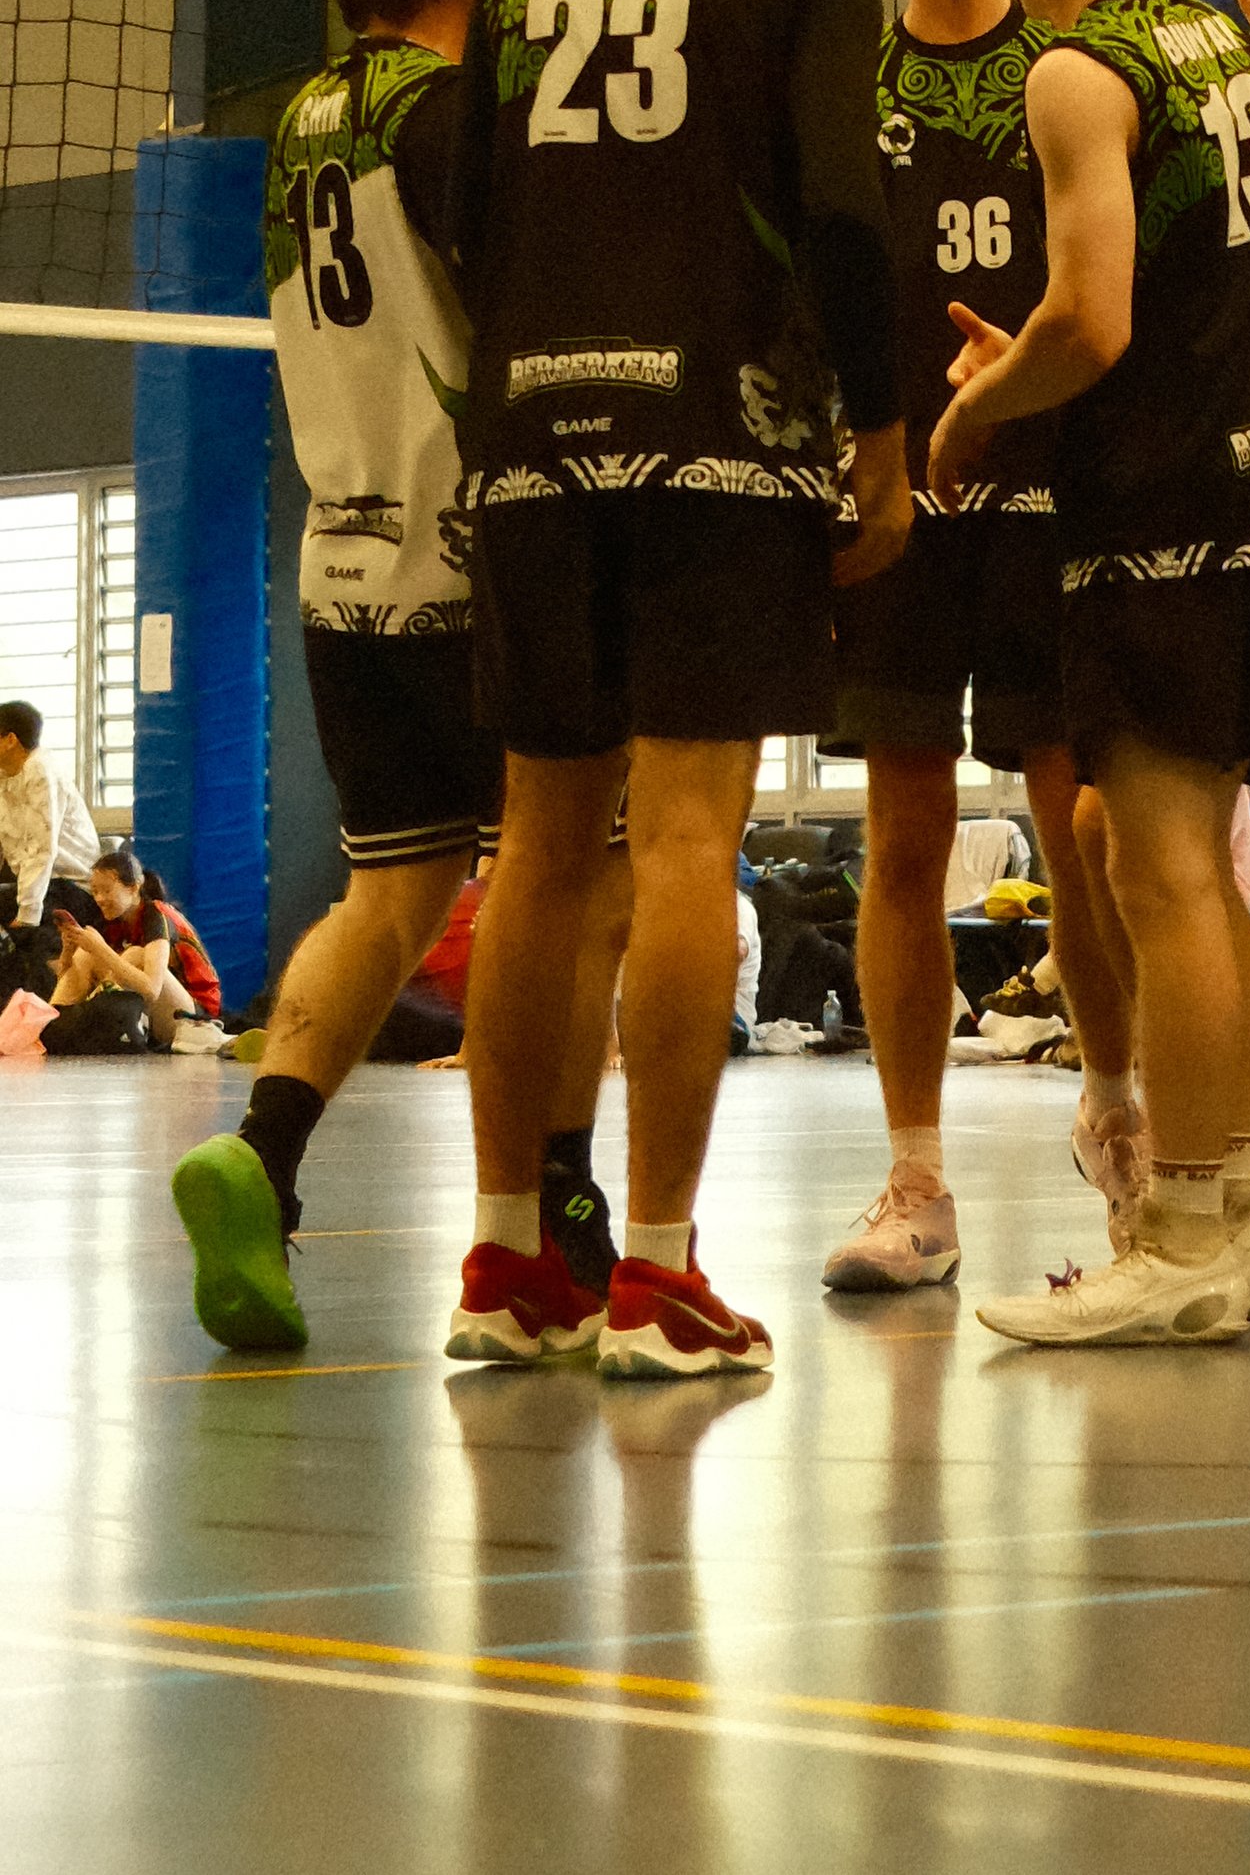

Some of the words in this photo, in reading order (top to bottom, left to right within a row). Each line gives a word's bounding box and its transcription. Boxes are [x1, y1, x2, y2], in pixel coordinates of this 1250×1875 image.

[286, 160, 373, 330] 13
[937, 196, 1012, 274] 36
[509, 351, 679, 400] BERSERKERS
[552, 417, 613, 437] GAME
[325, 565, 366, 582] GAME
